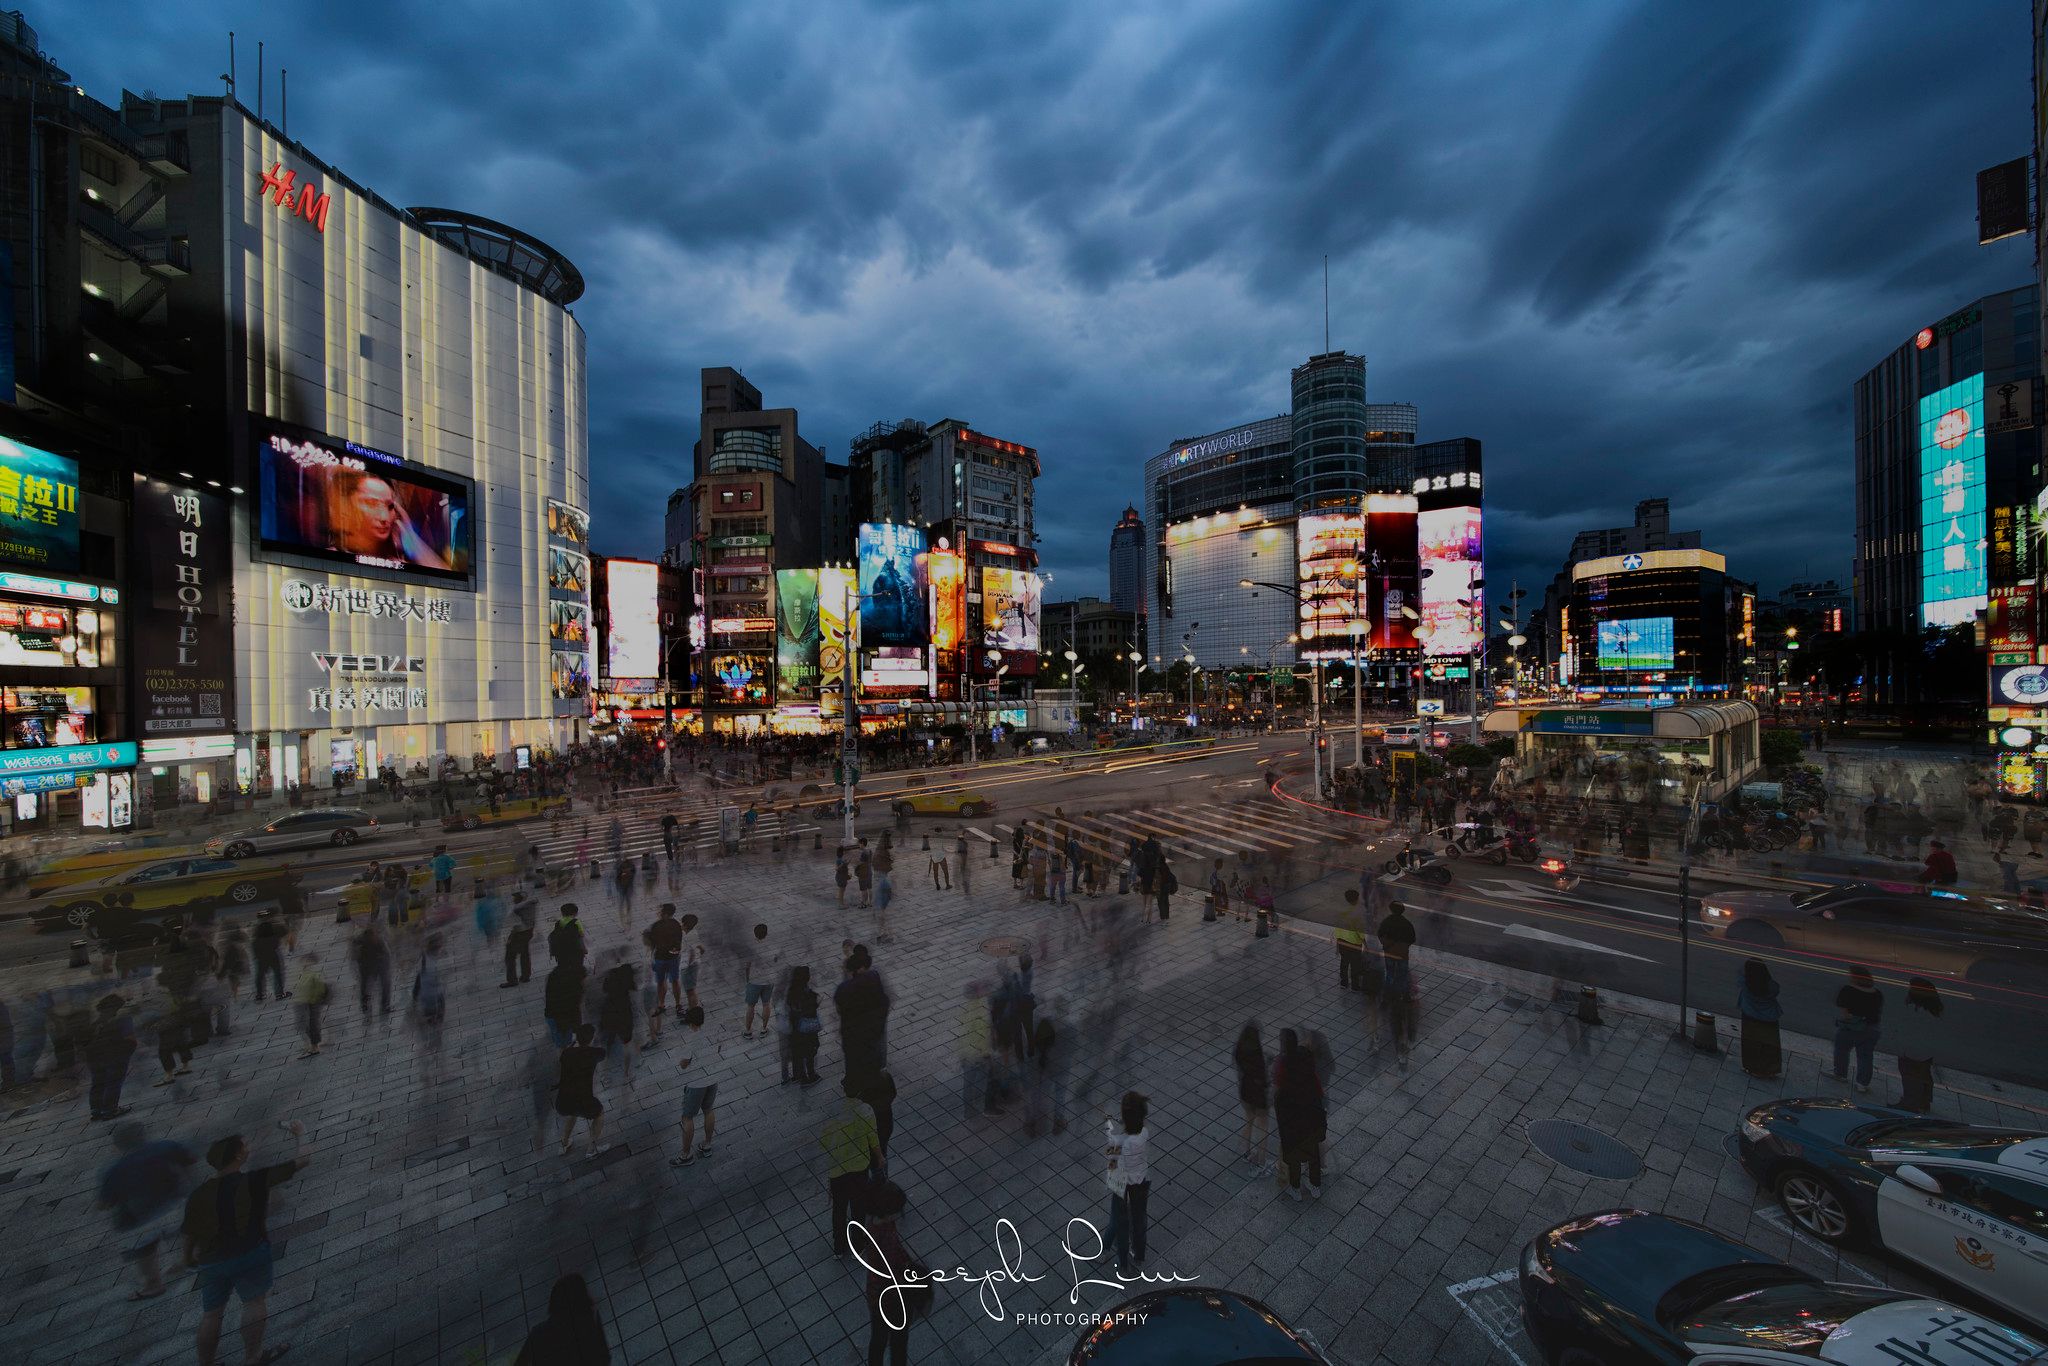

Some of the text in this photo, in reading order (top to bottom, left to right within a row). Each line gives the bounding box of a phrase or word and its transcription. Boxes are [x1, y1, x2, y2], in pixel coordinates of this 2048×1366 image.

[260, 163, 330, 233] H&M
[345, 441, 401, 467] Panasonic
[173, 494, 202, 667] 明日 HOTEL
[312, 583, 451, 624] 新世界大樓
[146, 678, 224, 692] (02)2375-5500
[1563, 715, 1601, 725] 西門站
[4, 754, 63, 769] watsons
